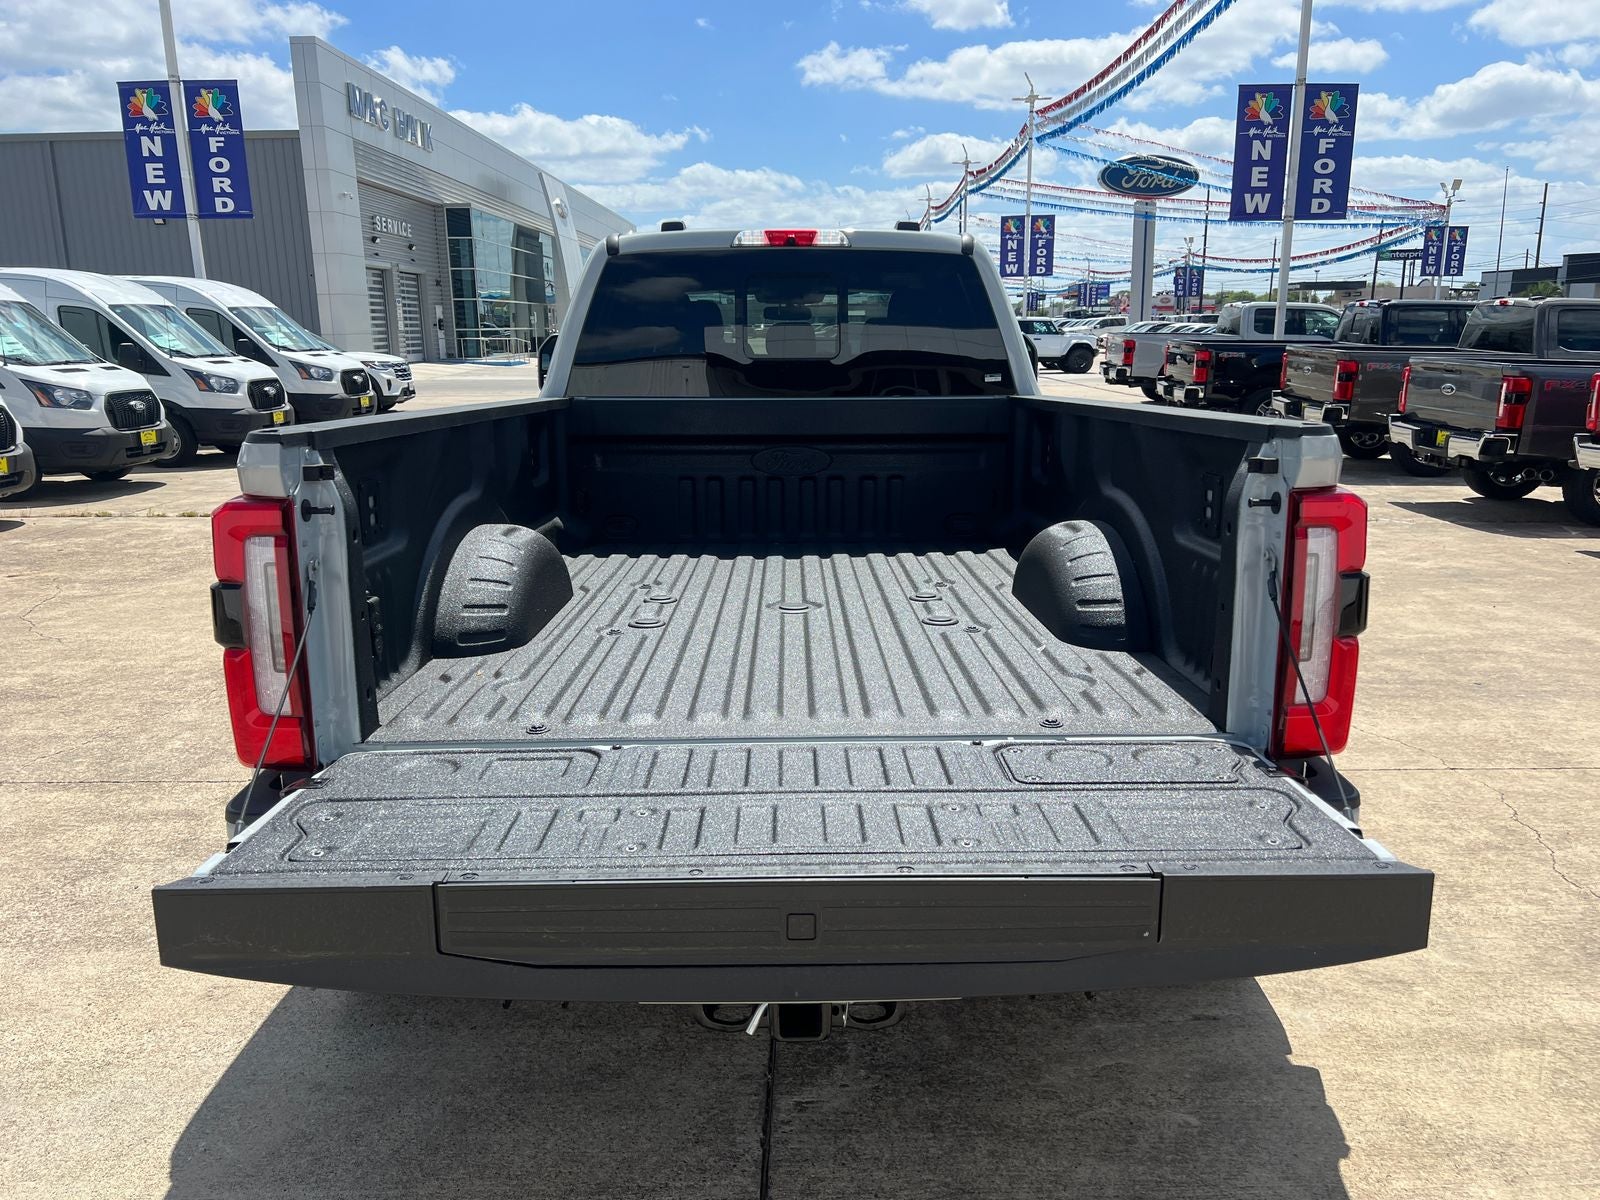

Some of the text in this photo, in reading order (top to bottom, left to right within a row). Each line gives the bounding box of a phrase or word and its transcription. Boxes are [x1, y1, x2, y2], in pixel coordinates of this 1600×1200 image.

[346, 82, 433, 152] MAC HAIK
[140, 136, 172, 211] NEW
[208, 137, 235, 213] FORD
[1121, 164, 1181, 188] Ford
[1244, 139, 1272, 213] NEW
[1310, 138, 1336, 213] FORD
[375, 215, 412, 238] SERVICE
[1005, 239, 1018, 274] NEW
[1036, 239, 1047, 274] FORD
[1383, 251, 1424, 259] enterpri
[1425, 246, 1436, 275] NEW
[1449, 246, 1461, 275] FORD
